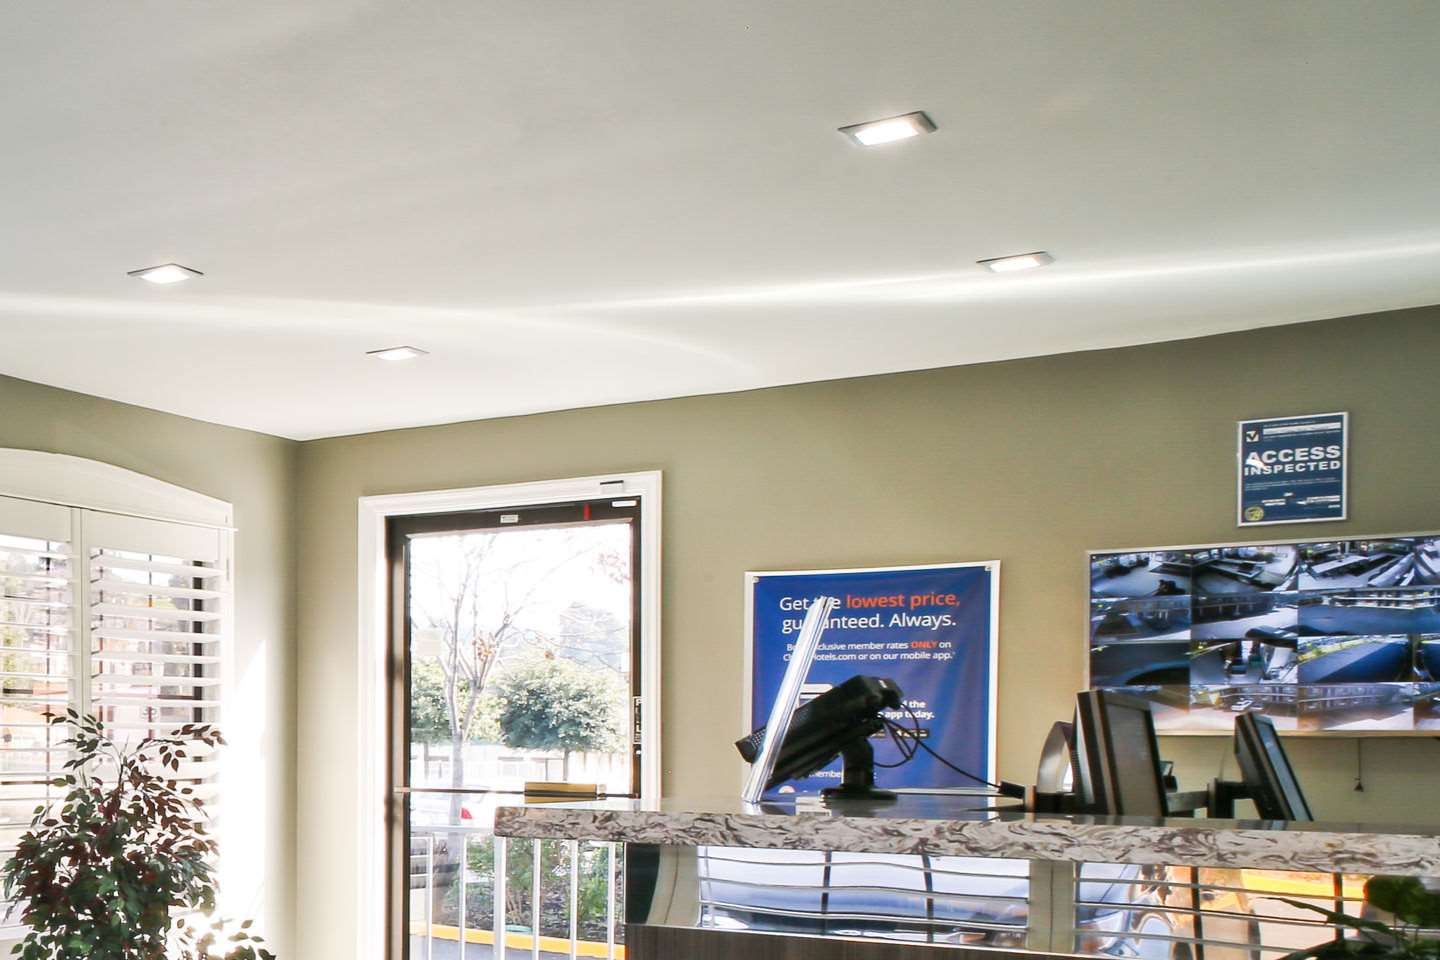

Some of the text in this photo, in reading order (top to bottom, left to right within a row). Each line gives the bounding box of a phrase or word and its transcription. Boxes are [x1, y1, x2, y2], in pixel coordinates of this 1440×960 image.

[1246, 445, 1341, 464] ACCESS
[1244, 460, 1341, 476] INSPECTED
[779, 596, 810, 611] Get
[846, 594, 905, 609] lowest
[911, 592, 960, 610] price,
[889, 612, 957, 631] Always.
[848, 641, 885, 650] member
[886, 641, 909, 649] rates
[911, 641, 938, 649] ONLY
[938, 641, 952, 649] on
[858, 653, 868, 661] or
[900, 651, 931, 660] mobile
[909, 700, 926, 708] the
[884, 711, 903, 720] app
